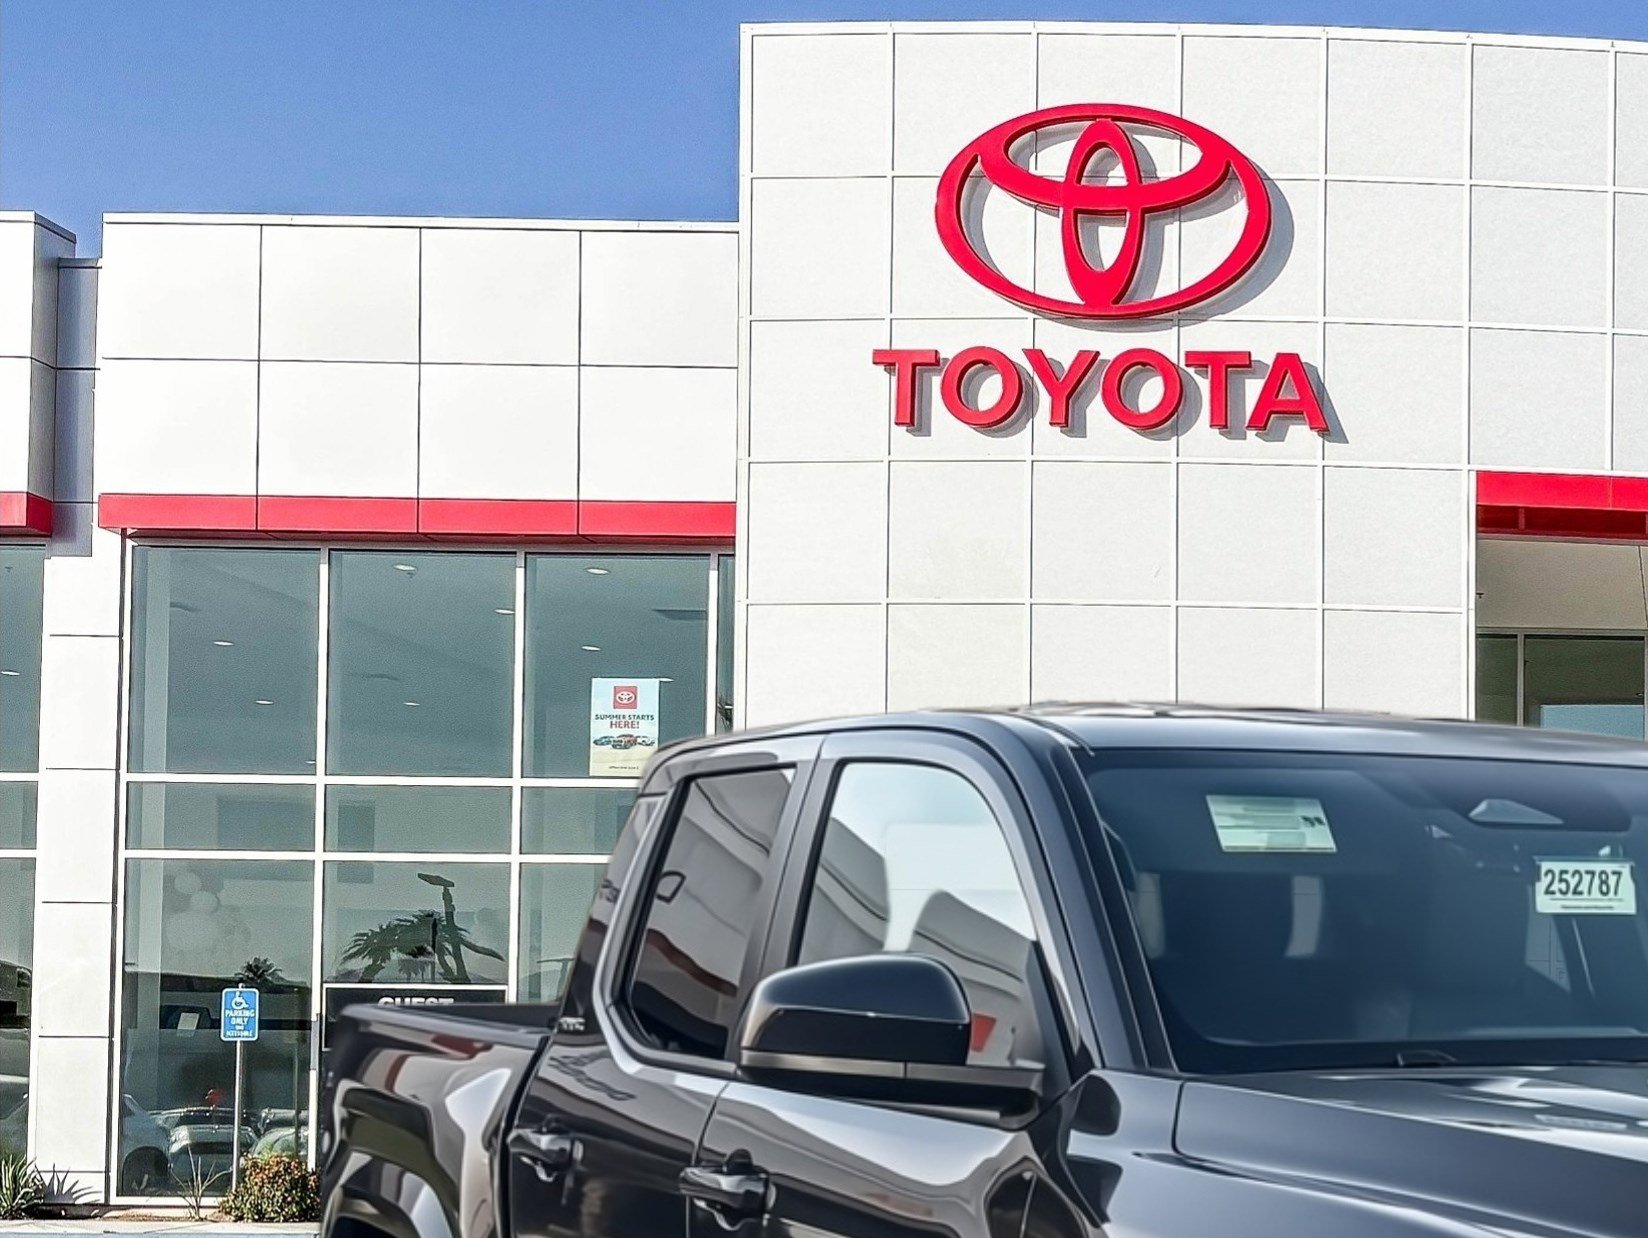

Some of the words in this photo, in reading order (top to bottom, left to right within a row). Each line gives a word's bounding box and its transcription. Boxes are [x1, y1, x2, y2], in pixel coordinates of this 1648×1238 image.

[872, 345, 1330, 433] TOYOTA
[609, 720, 640, 729] HERE!
[1543, 868, 1623, 897] 252787
[225, 1009, 255, 1018] PARKING
[230, 1017, 250, 1025] ONLY
